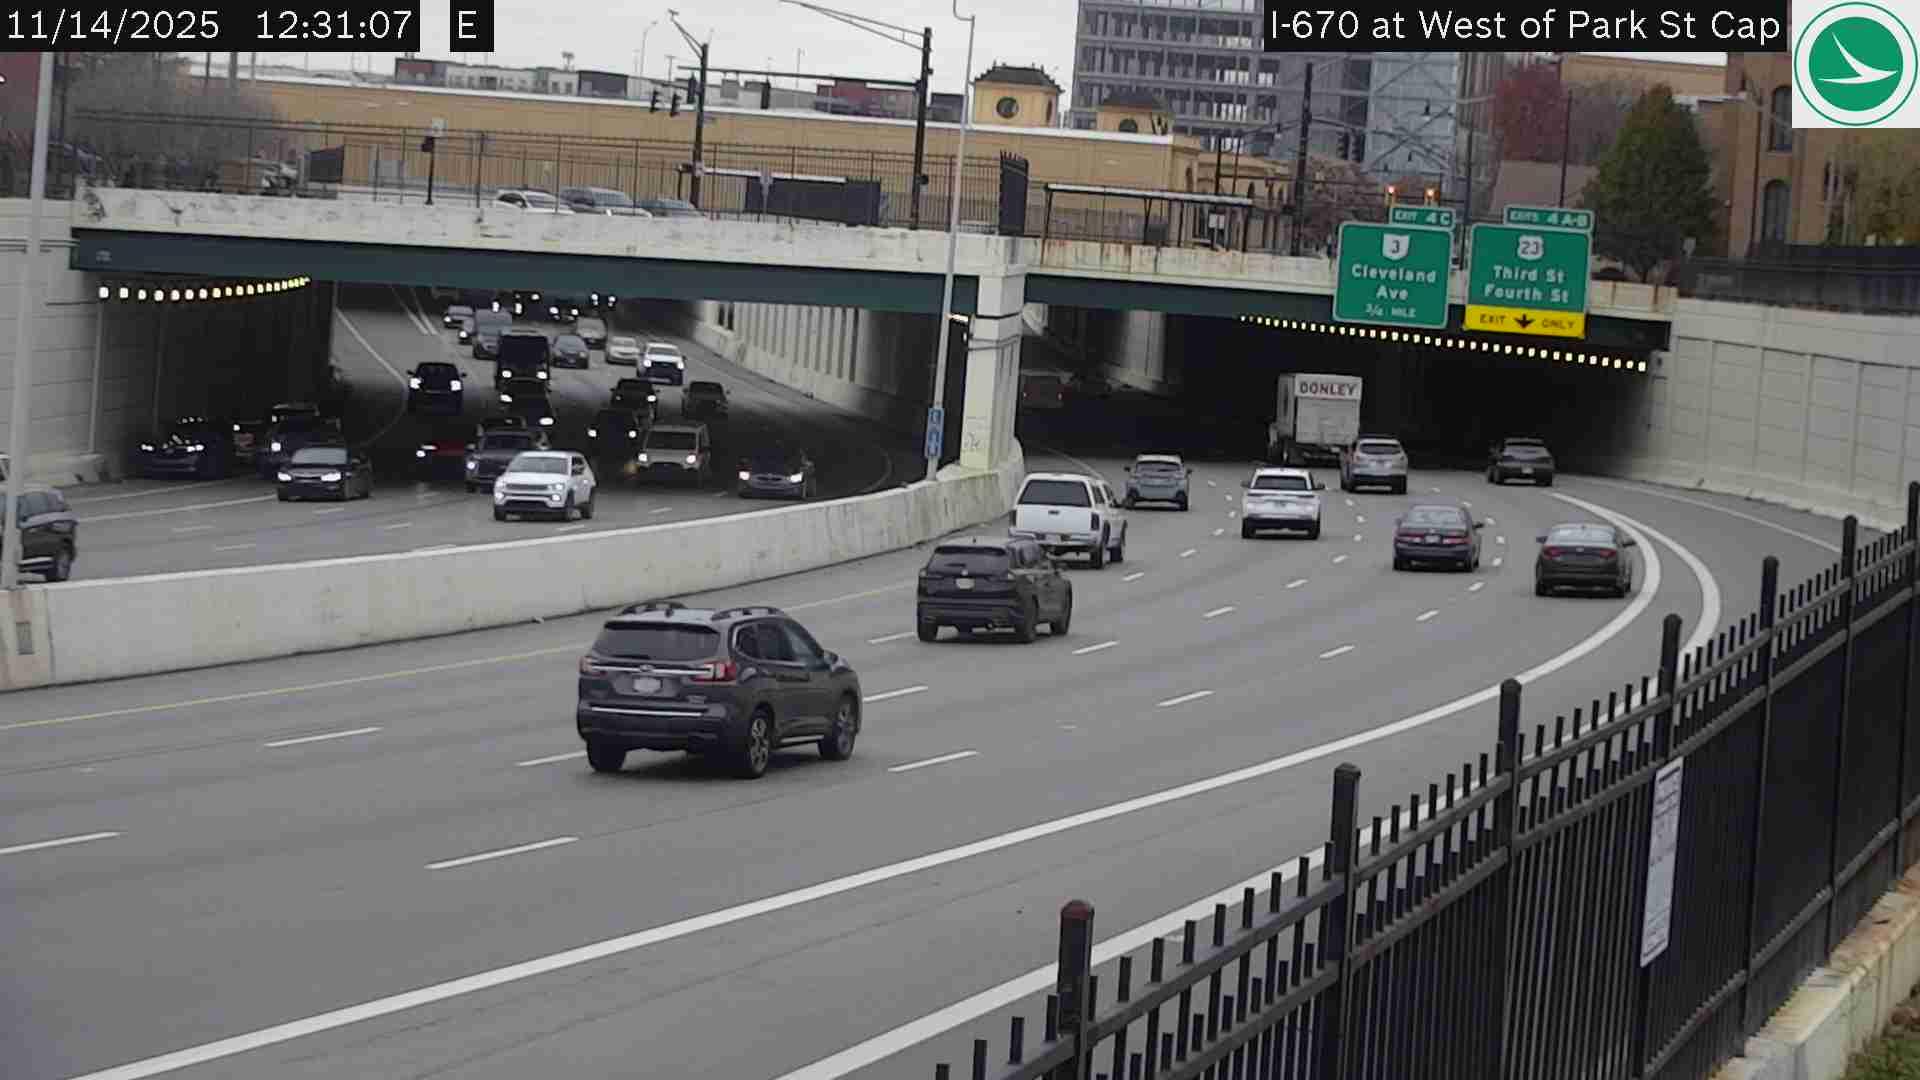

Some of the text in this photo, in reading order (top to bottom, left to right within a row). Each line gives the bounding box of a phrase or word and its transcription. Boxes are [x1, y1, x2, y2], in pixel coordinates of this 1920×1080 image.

[1391, 239, 1400, 254] 3
[1520, 241, 1540, 256] 23
[1351, 263, 1437, 283] Cleveland
[1493, 264, 1565, 284] Third St
[1376, 285, 1409, 300] Ave
[1484, 283, 1569, 303] Fourth St
[1391, 306, 1417, 318] MILE
[1480, 313, 1576, 329] EXIT ONLY
